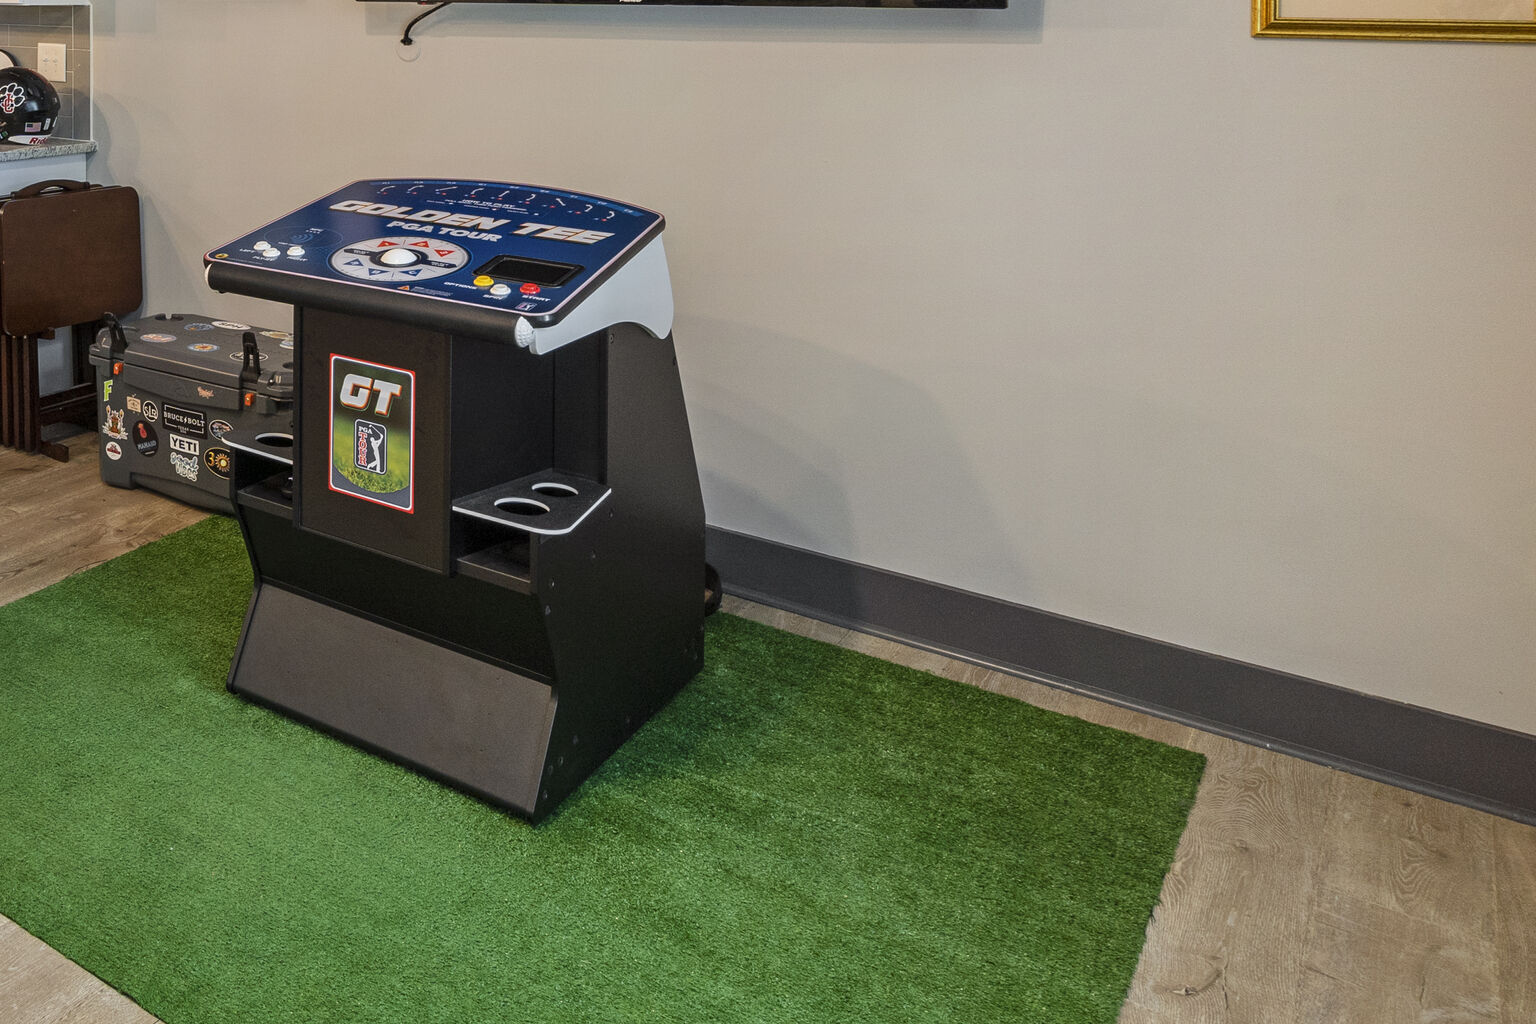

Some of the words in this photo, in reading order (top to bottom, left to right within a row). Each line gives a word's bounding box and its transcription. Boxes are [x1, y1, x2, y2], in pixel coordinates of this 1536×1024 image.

[329, 200, 512, 231] GOLDEN
[511, 222, 616, 244] TEE
[387, 221, 434, 233] PGA
[437, 227, 503, 242] TOUR
[443, 281, 478, 290] OPTIONS
[104, 379, 113, 401] F
[340, 374, 402, 416] GT
[164, 411, 184, 423] BRUCE
[187, 417, 205, 427] BOLT
[358, 425, 373, 435] PGA
[171, 436, 197, 453] YETI
[358, 432, 368, 466] TOUR
